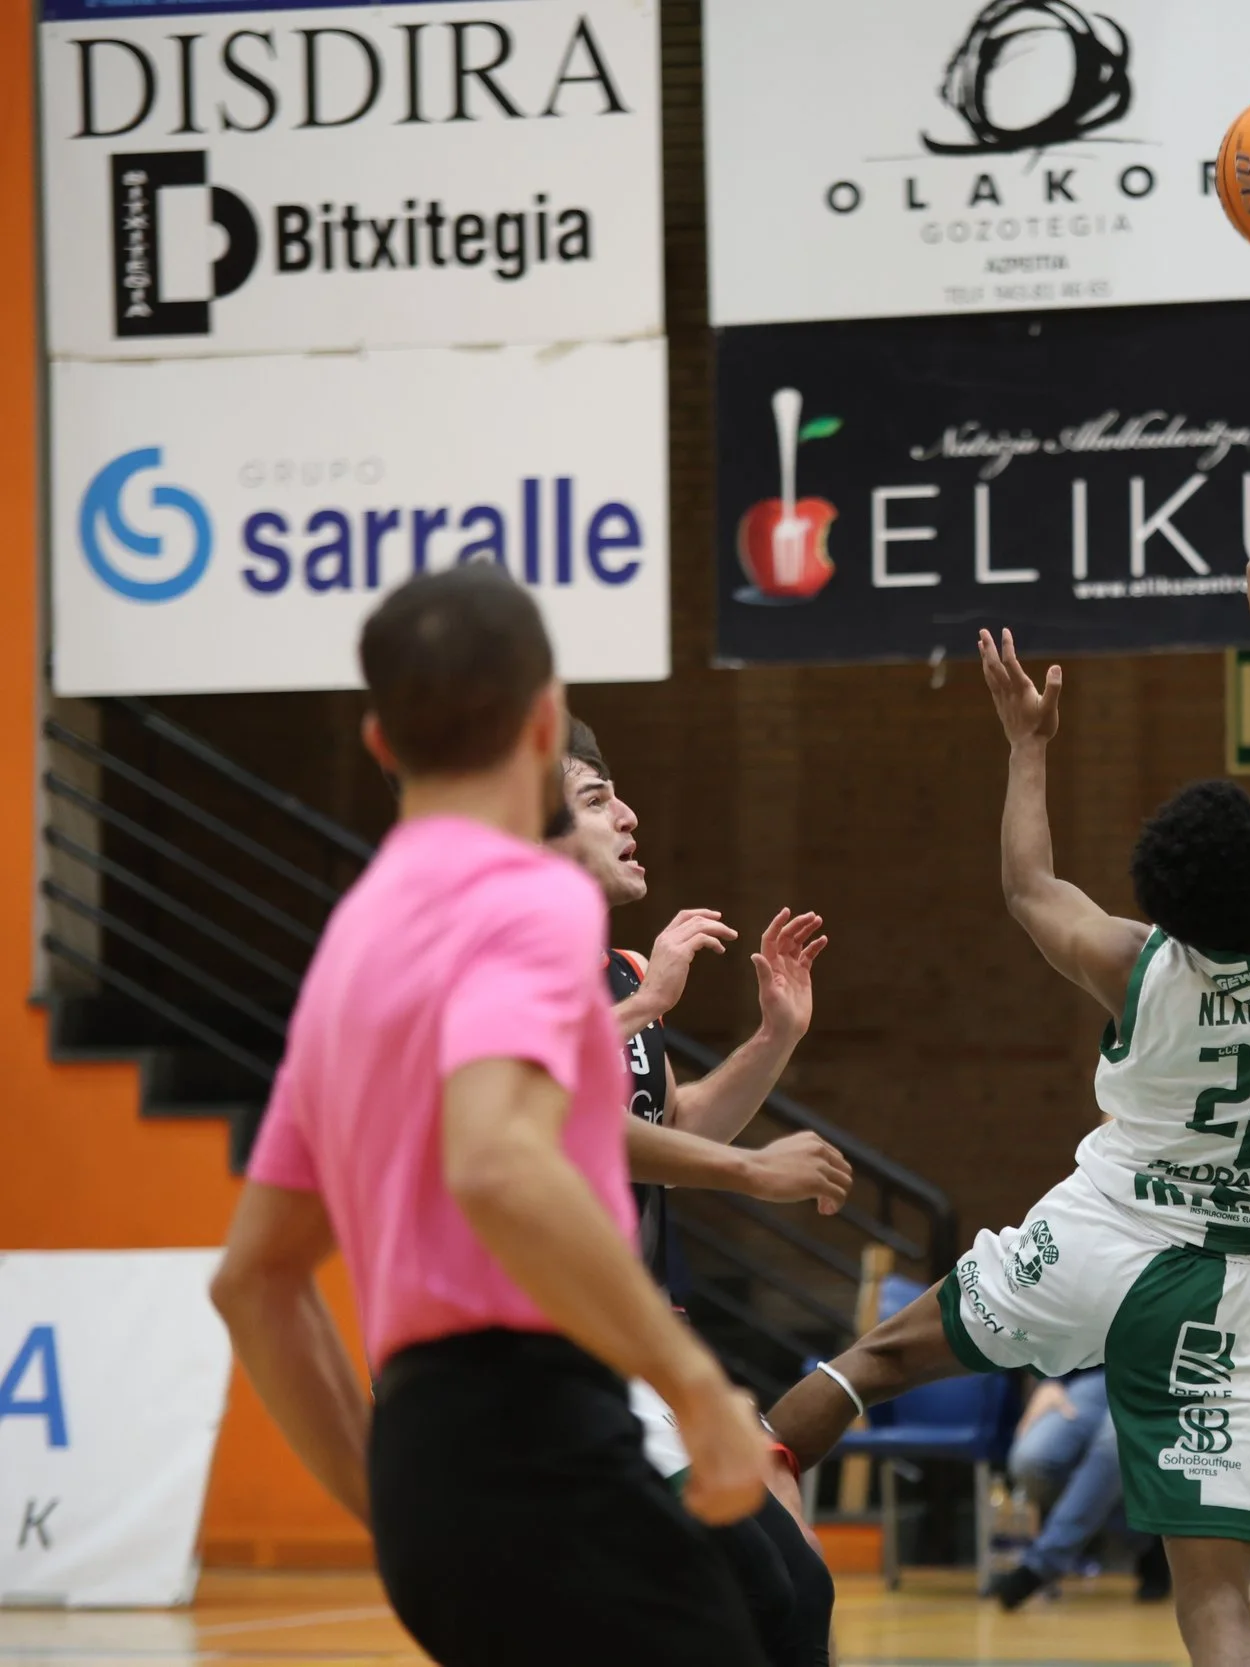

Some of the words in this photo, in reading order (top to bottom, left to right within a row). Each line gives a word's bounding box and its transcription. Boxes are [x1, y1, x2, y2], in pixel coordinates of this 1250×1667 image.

[66, 15, 636, 140] DISDIRA
[274, 193, 592, 283] Bitxitegia
[920, 213, 1133, 245] GOZOTEGIA
[238, 457, 387, 489] GRUPO
[240, 476, 644, 595] sarralle
[1190, 1207, 1240, 1222] INSTALACIONES
[0, 1324, 70, 1451] A
[1163, 1453, 1242, 1471] SohoBoutique
[1188, 1467, 1218, 1477] HOTELS
[18, 1498, 58, 1549] K
